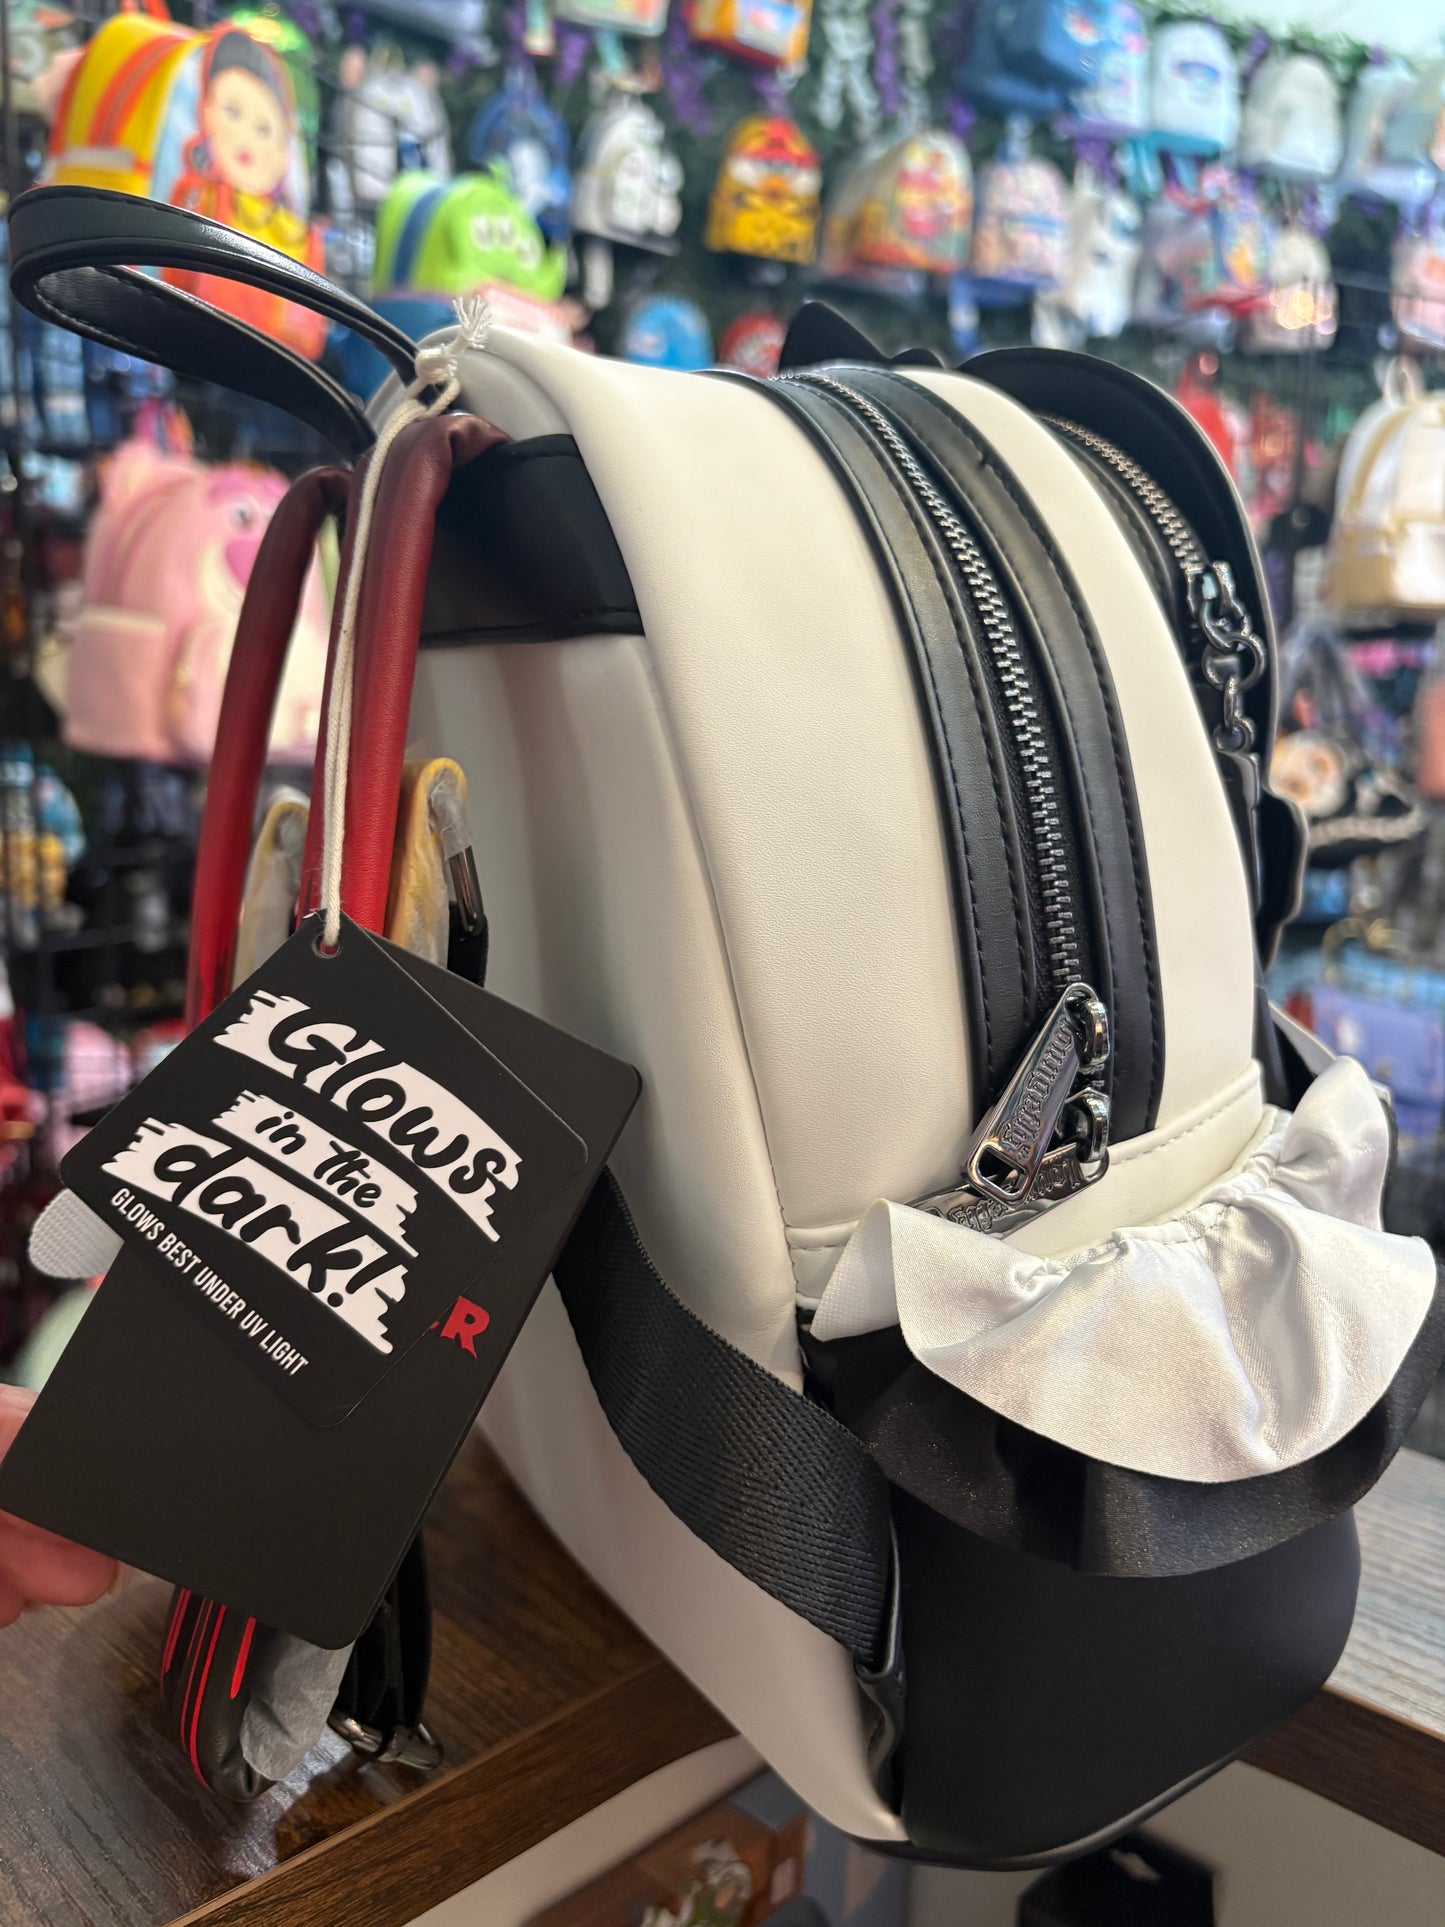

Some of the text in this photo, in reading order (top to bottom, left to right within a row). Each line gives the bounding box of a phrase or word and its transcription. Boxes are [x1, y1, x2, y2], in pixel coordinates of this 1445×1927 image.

[255, 1111, 382, 1208] in the
[267, 1007, 507, 1195] Glows
[110, 1187, 309, 1376] GLOWS BEST UNDER UV LIGHT
[153, 1144, 402, 1308] dark!
[429, 1294, 490, 1360] R
